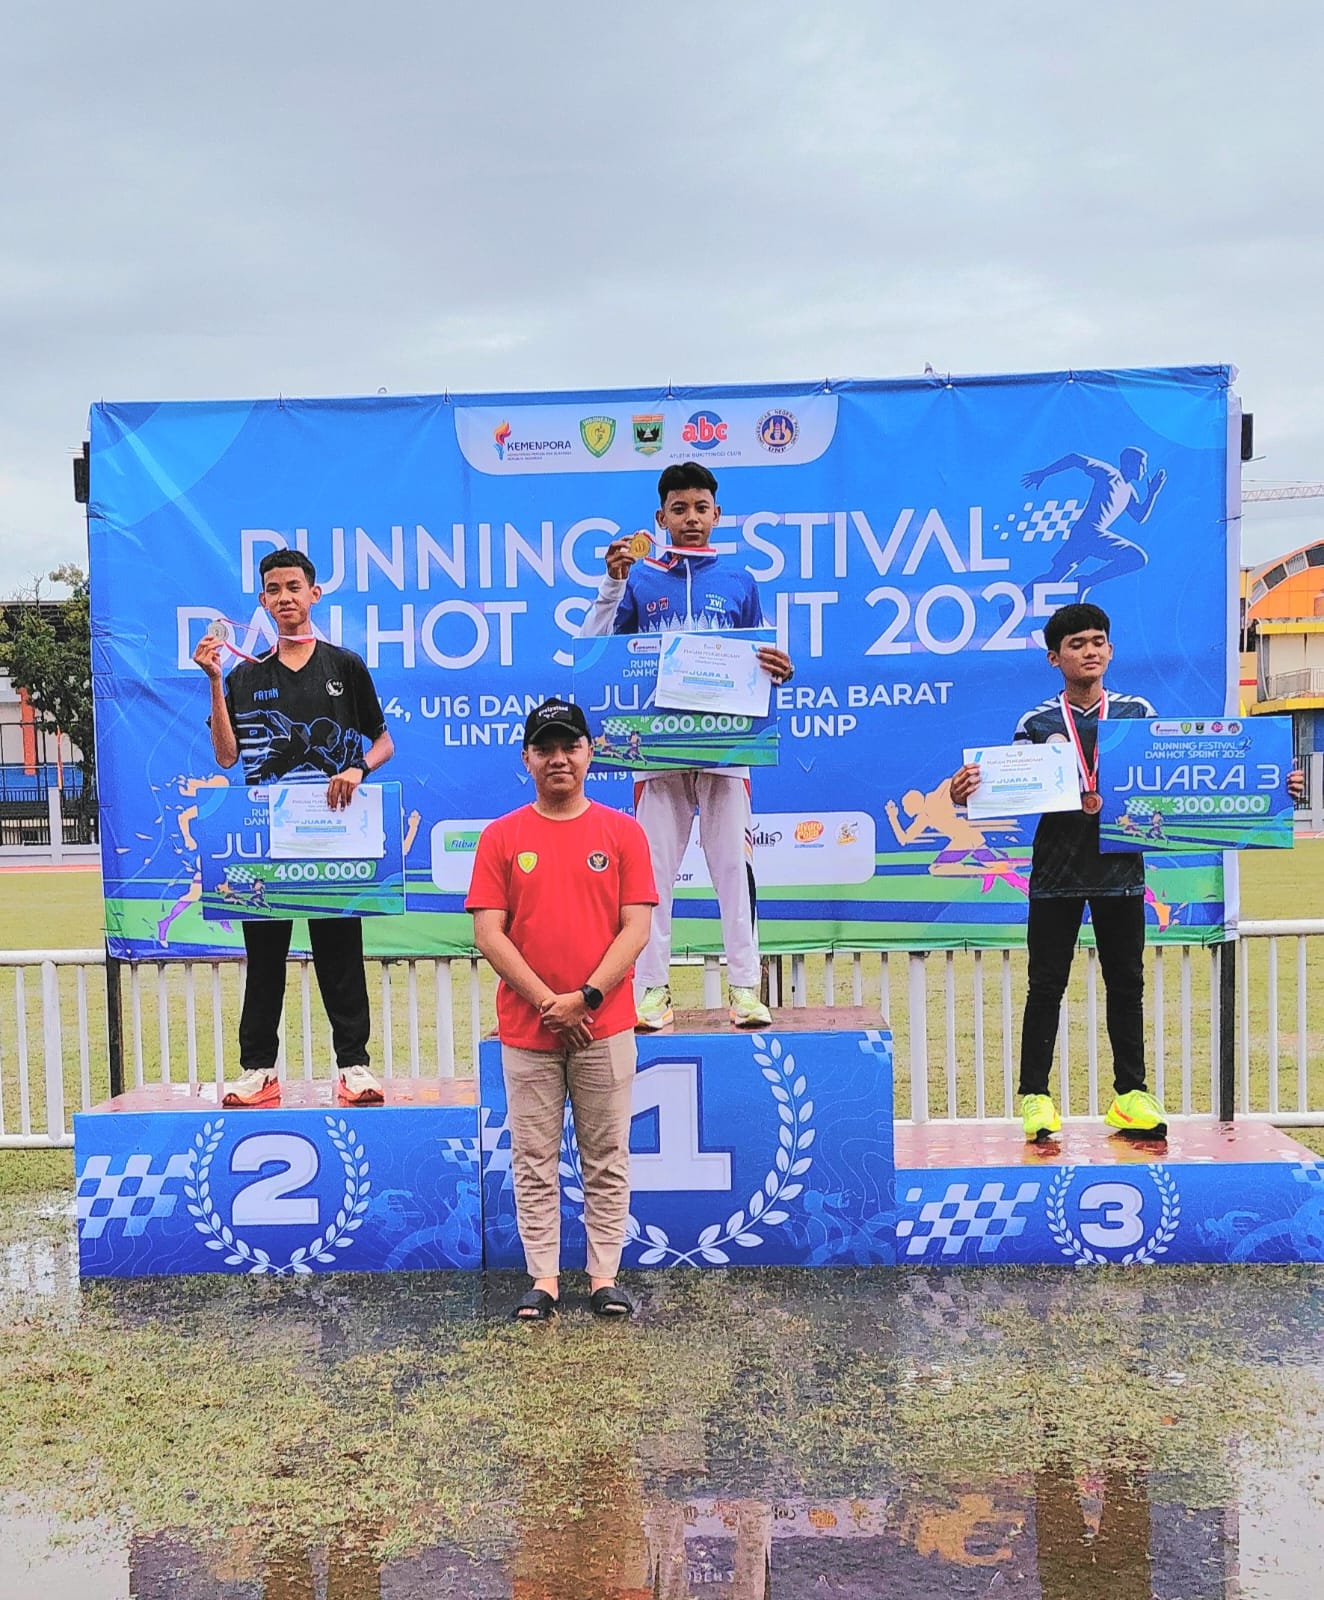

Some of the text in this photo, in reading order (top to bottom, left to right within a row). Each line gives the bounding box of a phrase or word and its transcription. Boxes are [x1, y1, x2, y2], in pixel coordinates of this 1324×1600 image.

[682, 416, 728, 442] abc
[507, 441, 572, 451] KEMENPORA
[655, 506, 1010, 582] STIVAL
[366, 598, 527, 670] HOT
[421, 696, 470, 718] U16
[848, 682, 953, 707] BARAT
[650, 716, 747, 732] 600.000
[791, 715, 857, 738] UNP
[1145, 751, 1165, 759] DAN
[1166, 751, 1184, 759] HOT
[1153, 741, 1236, 751] RUNNING FESTIVAL
[1114, 764, 1280, 791] JUARA 3
[1172, 796, 1265, 813] 300.000
[274, 862, 371, 880] 400.000
[231, 1134, 319, 1226] 2
[1079, 1183, 1144, 1248] 3
